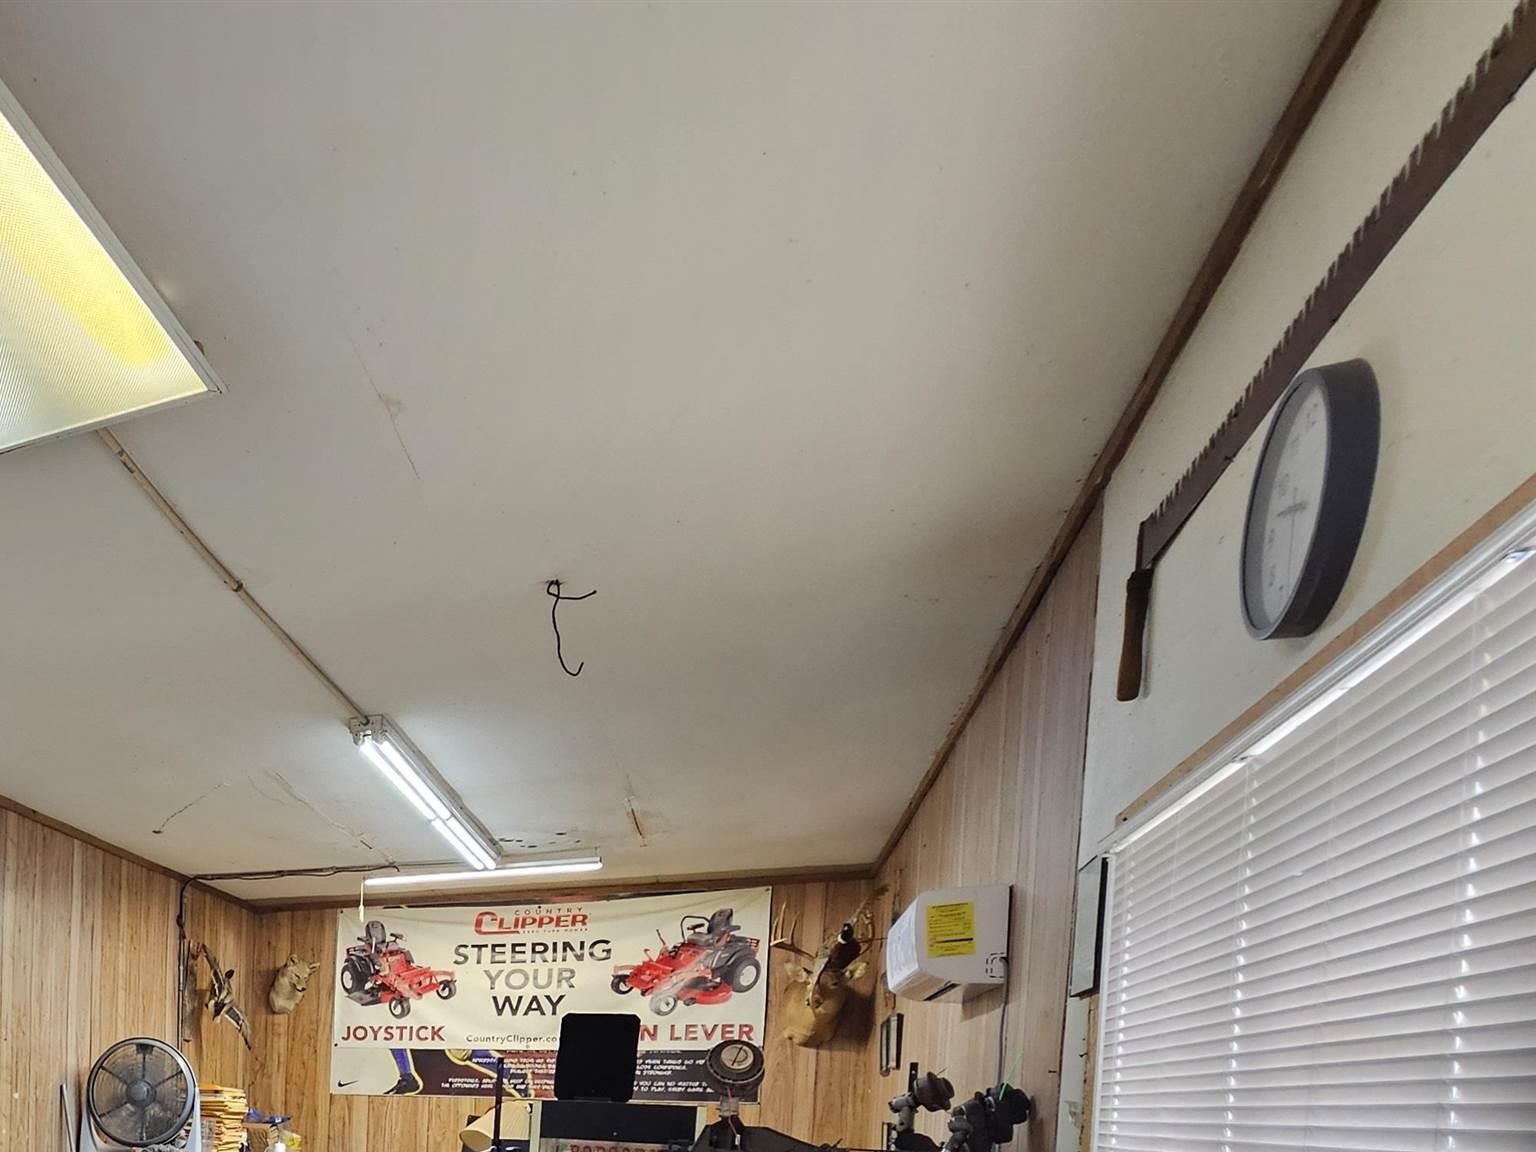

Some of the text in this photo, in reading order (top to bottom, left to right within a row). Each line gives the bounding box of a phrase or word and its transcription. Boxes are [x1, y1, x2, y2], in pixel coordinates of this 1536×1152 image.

[513, 906, 584, 916] COUNTRY
[474, 911, 590, 936] CLIPPER
[453, 939, 613, 966] STEERING
[483, 967, 577, 991] YOUR
[491, 994, 567, 1017] WAY
[341, 1024, 446, 1042] JOYSTICK
[466, 1034, 558, 1045] CountryClipper.co
[670, 1023, 755, 1041] LEVER
